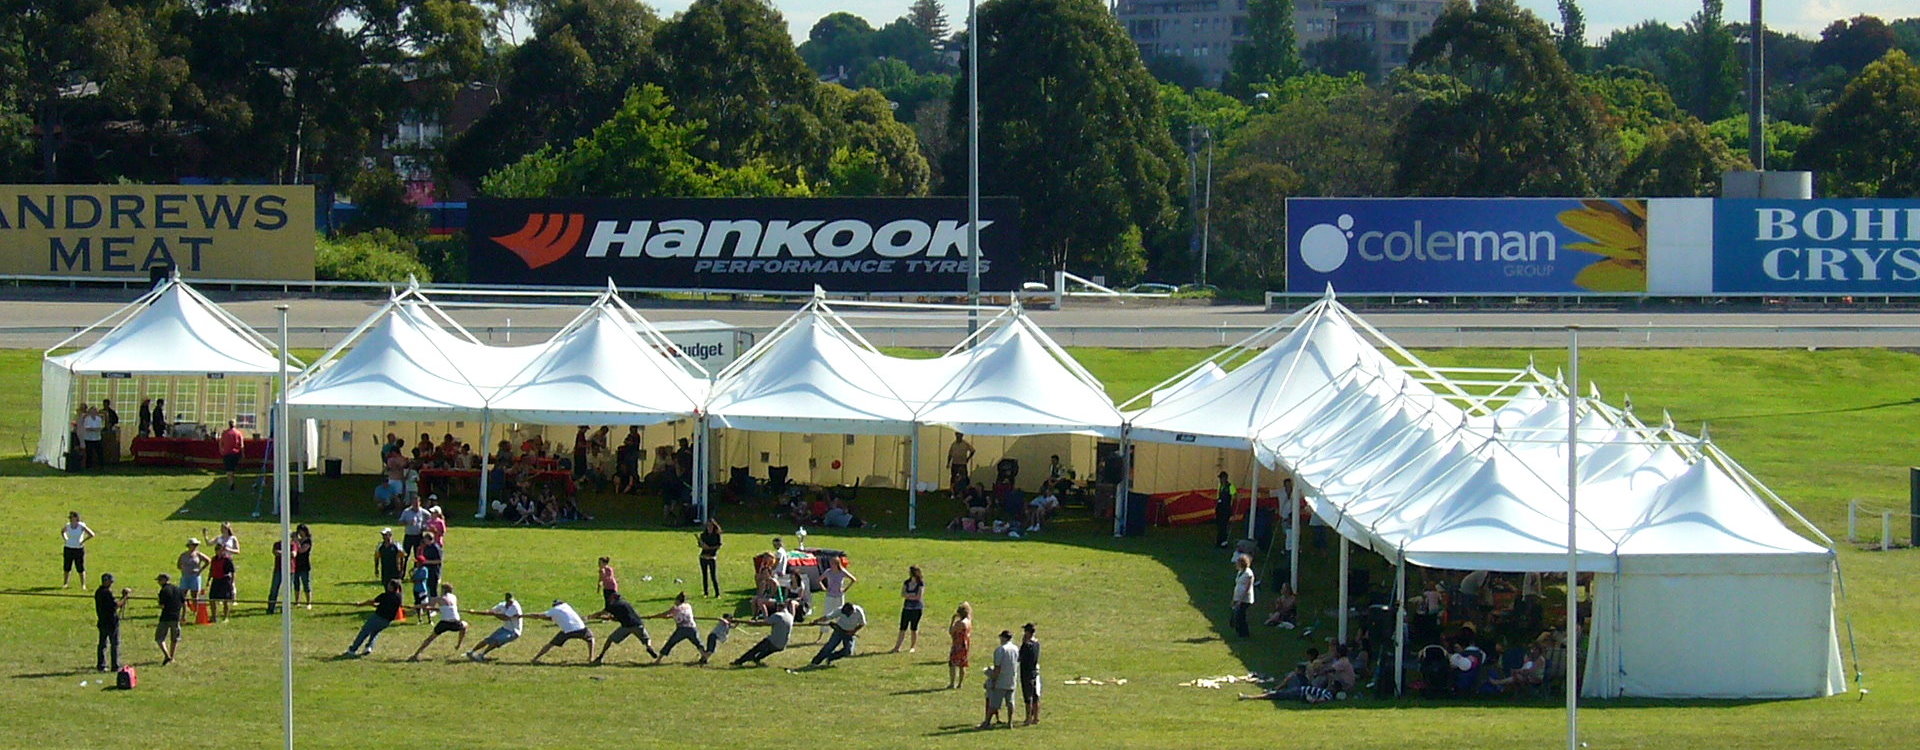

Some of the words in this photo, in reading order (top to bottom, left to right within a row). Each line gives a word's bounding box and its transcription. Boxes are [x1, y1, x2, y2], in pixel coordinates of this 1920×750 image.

[0, 194, 288, 231] NDREWS
[49, 236, 213, 272] MEAT
[1358, 220, 1556, 262] coleman
[694, 260, 895, 273] PERFORMANCE
[905, 260, 992, 273] TYRES
[1503, 265, 1554, 277] GROUP
